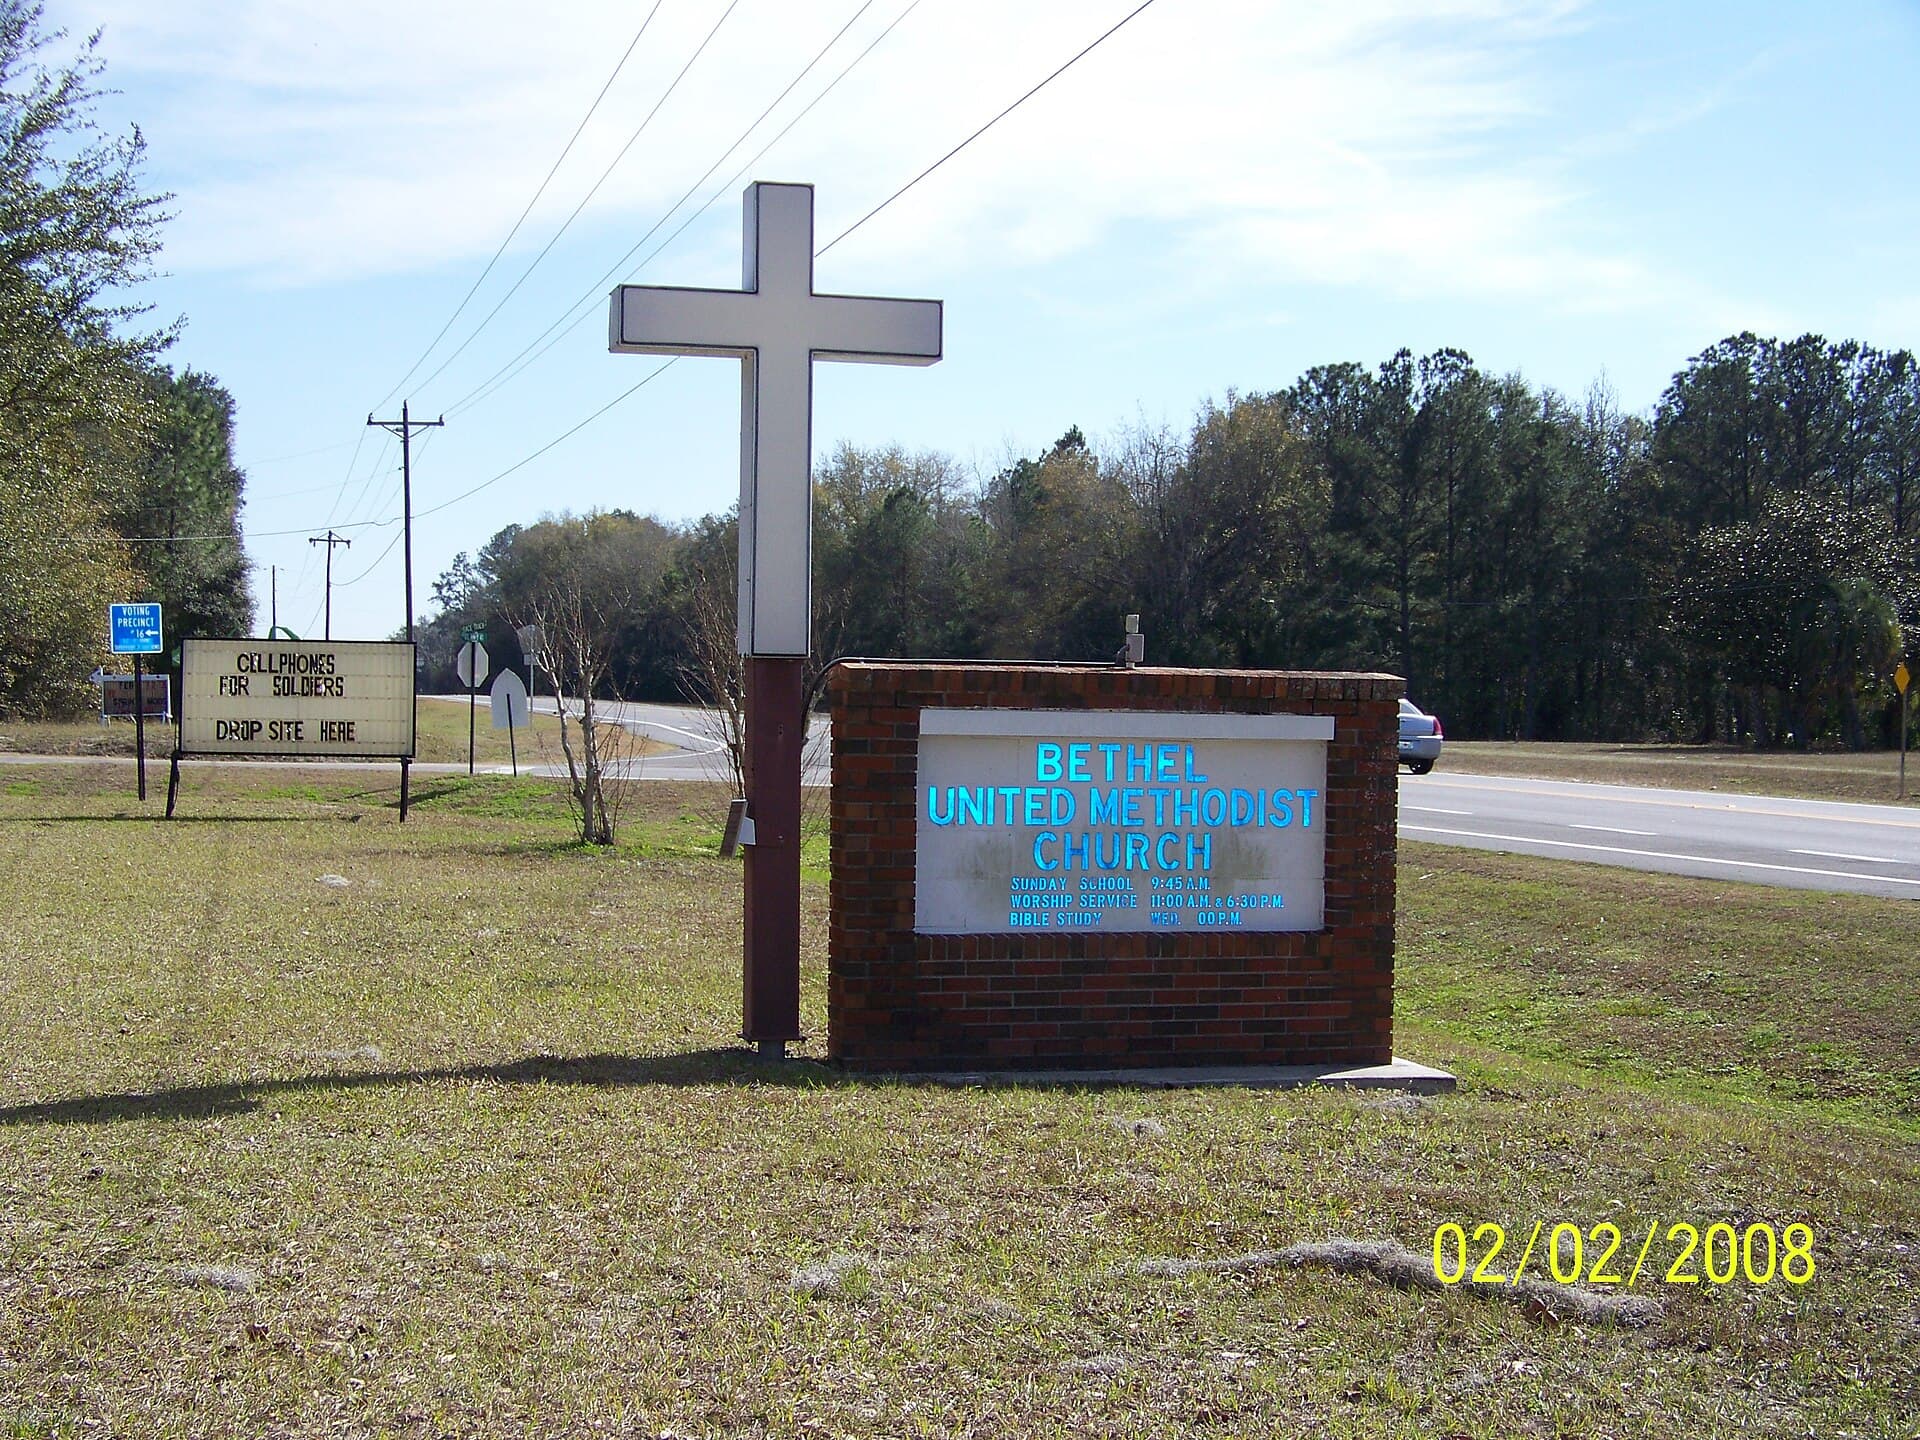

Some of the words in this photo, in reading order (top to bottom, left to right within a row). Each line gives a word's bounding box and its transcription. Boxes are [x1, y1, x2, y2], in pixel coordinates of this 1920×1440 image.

[122, 606, 150, 616] VOTING
[117, 617, 154, 628] PRECINCT
[237, 652, 335, 675] CELLPHONES
[219, 675, 249, 696] FOR
[273, 675, 344, 697] SOLDIERS
[216, 720, 263, 741] DROP
[268, 720, 304, 741] SITE
[1036, 743, 1209, 783] BETHEL
[928, 786, 1076, 826] UNITED
[1089, 788, 1319, 827] METHODIST
[1032, 831, 1213, 871] CHURCH
[1011, 877, 1067, 891] SUNDAY
[1079, 877, 1134, 891] SCHOOL
[1151, 876, 1183, 890] 9:45
[1186, 876, 1211, 890] A.M.
[1010, 894, 1073, 909] WORSHIP
[1079, 894, 1137, 909] SERVICE
[1151, 894, 1183, 908] 11:00
[1187, 894, 1212, 908] A.M.
[1226, 895, 1257, 908] 6:30
[1260, 895, 1285, 908] P.M.
[1009, 912, 1050, 926] BIBLE
[1056, 912, 1102, 926] STUDY
[1151, 912, 1181, 926] WED.
[1218, 912, 1242, 925] P.M.
